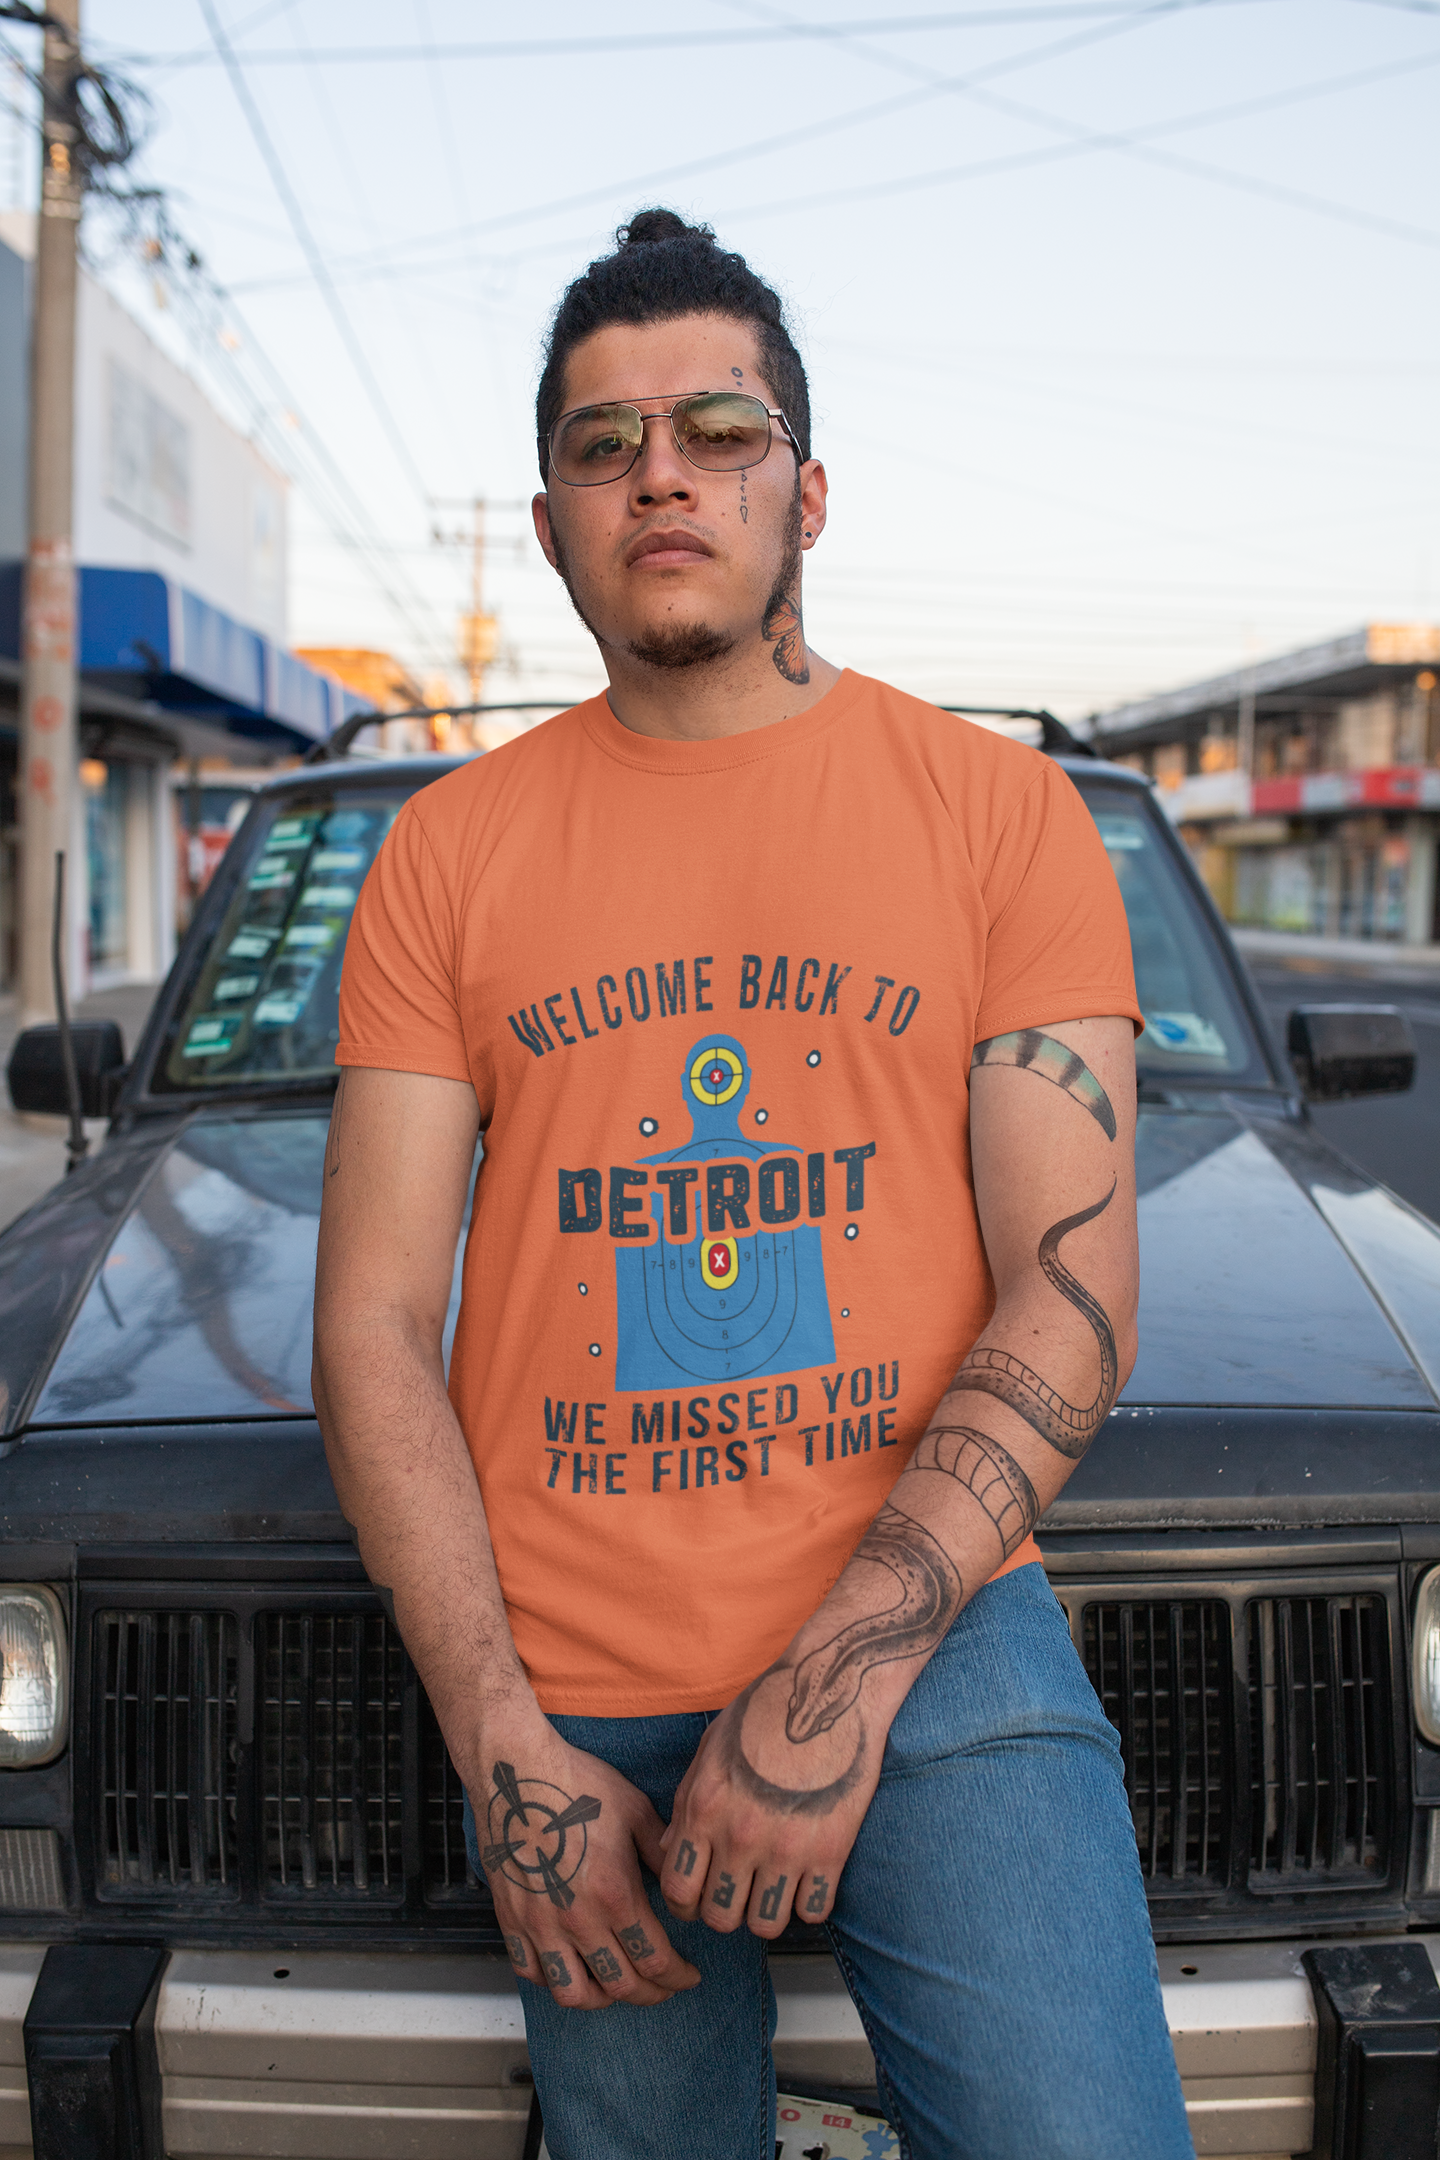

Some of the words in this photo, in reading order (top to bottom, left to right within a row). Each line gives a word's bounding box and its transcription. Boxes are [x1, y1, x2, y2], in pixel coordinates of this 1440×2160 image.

[507, 955, 714, 1058] WELCOME
[738, 954, 853, 1016] BACK
[863, 975, 921, 1037] TO
[713, 1071, 720, 1081] X
[558, 1141, 876, 1238] DETROIT
[669, 1259, 676, 1270] 8
[688, 1258, 695, 1268] 9
[713, 1251, 726, 1269] X
[744, 1251, 751, 1262] 9
[762, 1248, 770, 1259] 8
[719, 1299, 726, 1310] 9
[722, 1329, 729, 1340] 8
[725, 1362, 731, 1372] 7
[544, 1396, 607, 1445] WE
[631, 1383, 799, 1444] MISSED
[820, 1360, 900, 1414] YOU
[544, 1447, 627, 1495] THE
[652, 1434, 777, 1493] FIRST
[798, 1407, 898, 1467] TIME
